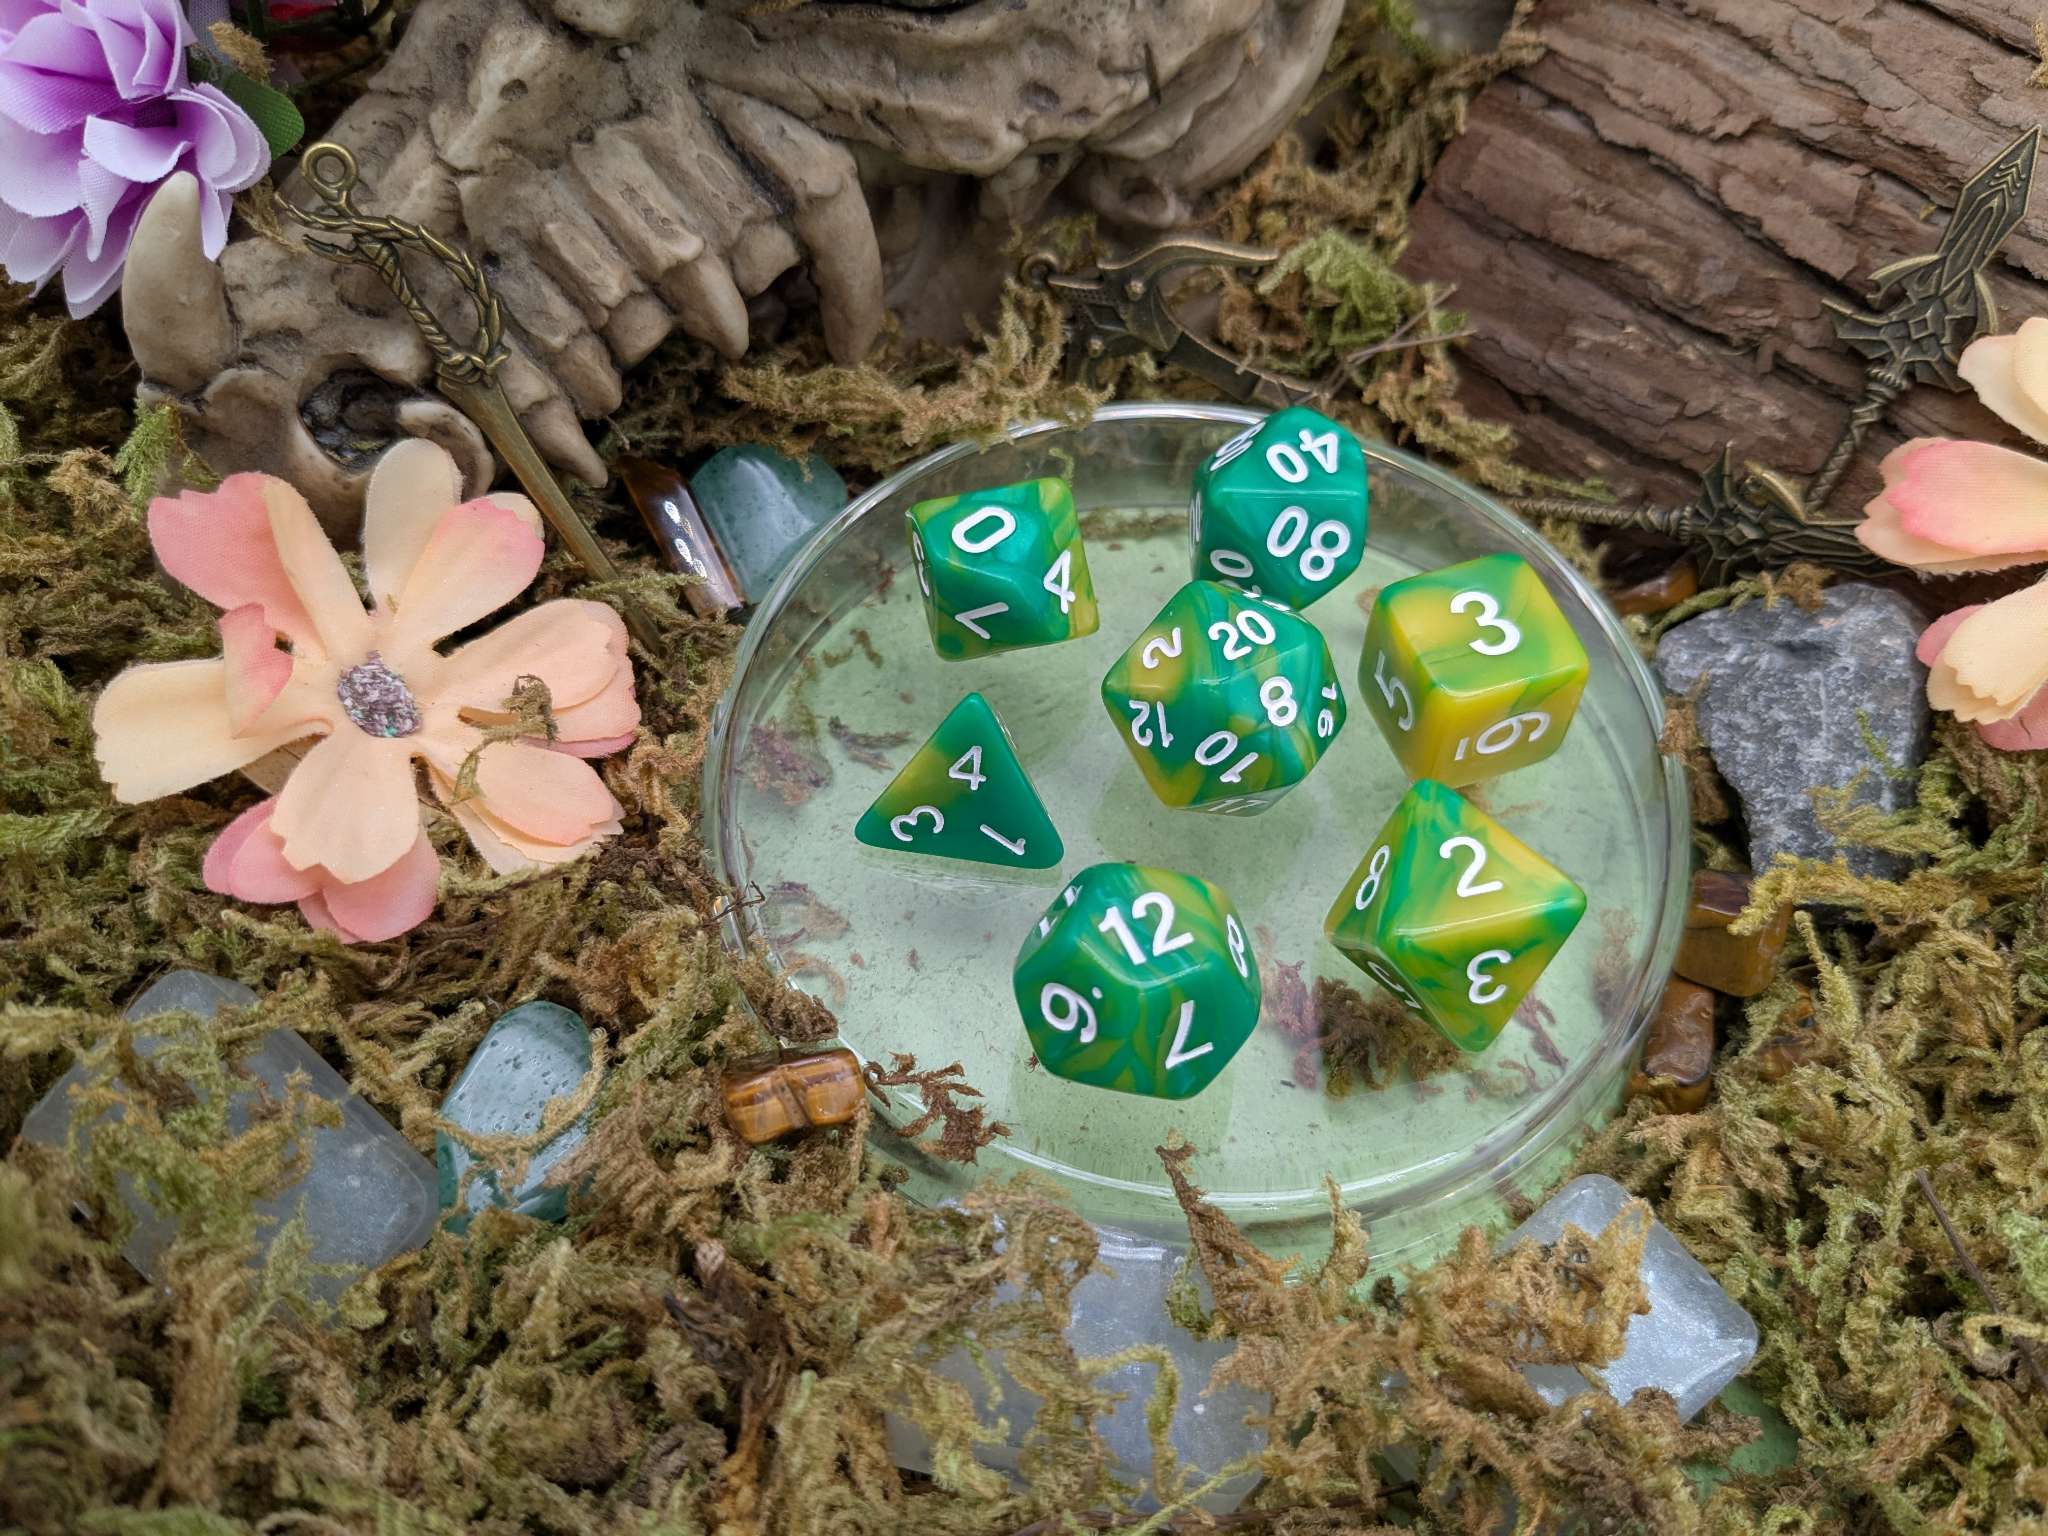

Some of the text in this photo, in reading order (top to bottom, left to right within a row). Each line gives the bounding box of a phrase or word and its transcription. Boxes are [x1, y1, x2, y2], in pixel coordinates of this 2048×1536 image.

[1266, 430, 1338, 482] 40
[951, 506, 1017, 554] 0
[1267, 506, 1350, 581] 80
[1044, 550, 1075, 613] 4
[1142, 627, 1183, 668] 2
[1208, 610, 1276, 660] 20
[1450, 591, 1520, 655] 3
[1259, 676, 1298, 726] 8
[1374, 651, 1415, 732] 5
[1129, 700, 1174, 747] 12
[949, 746, 987, 790] 4
[1194, 731, 1260, 783] 10
[890, 805, 945, 842] 3
[980, 824, 1026, 856] 1
[1355, 845, 1390, 910] 8
[1439, 837, 1503, 898] 2
[1098, 891, 1194, 966] 12
[1226, 914, 1248, 978] 8
[1467, 950, 1512, 1004] 3
[1164, 1000, 1214, 1070] 7
